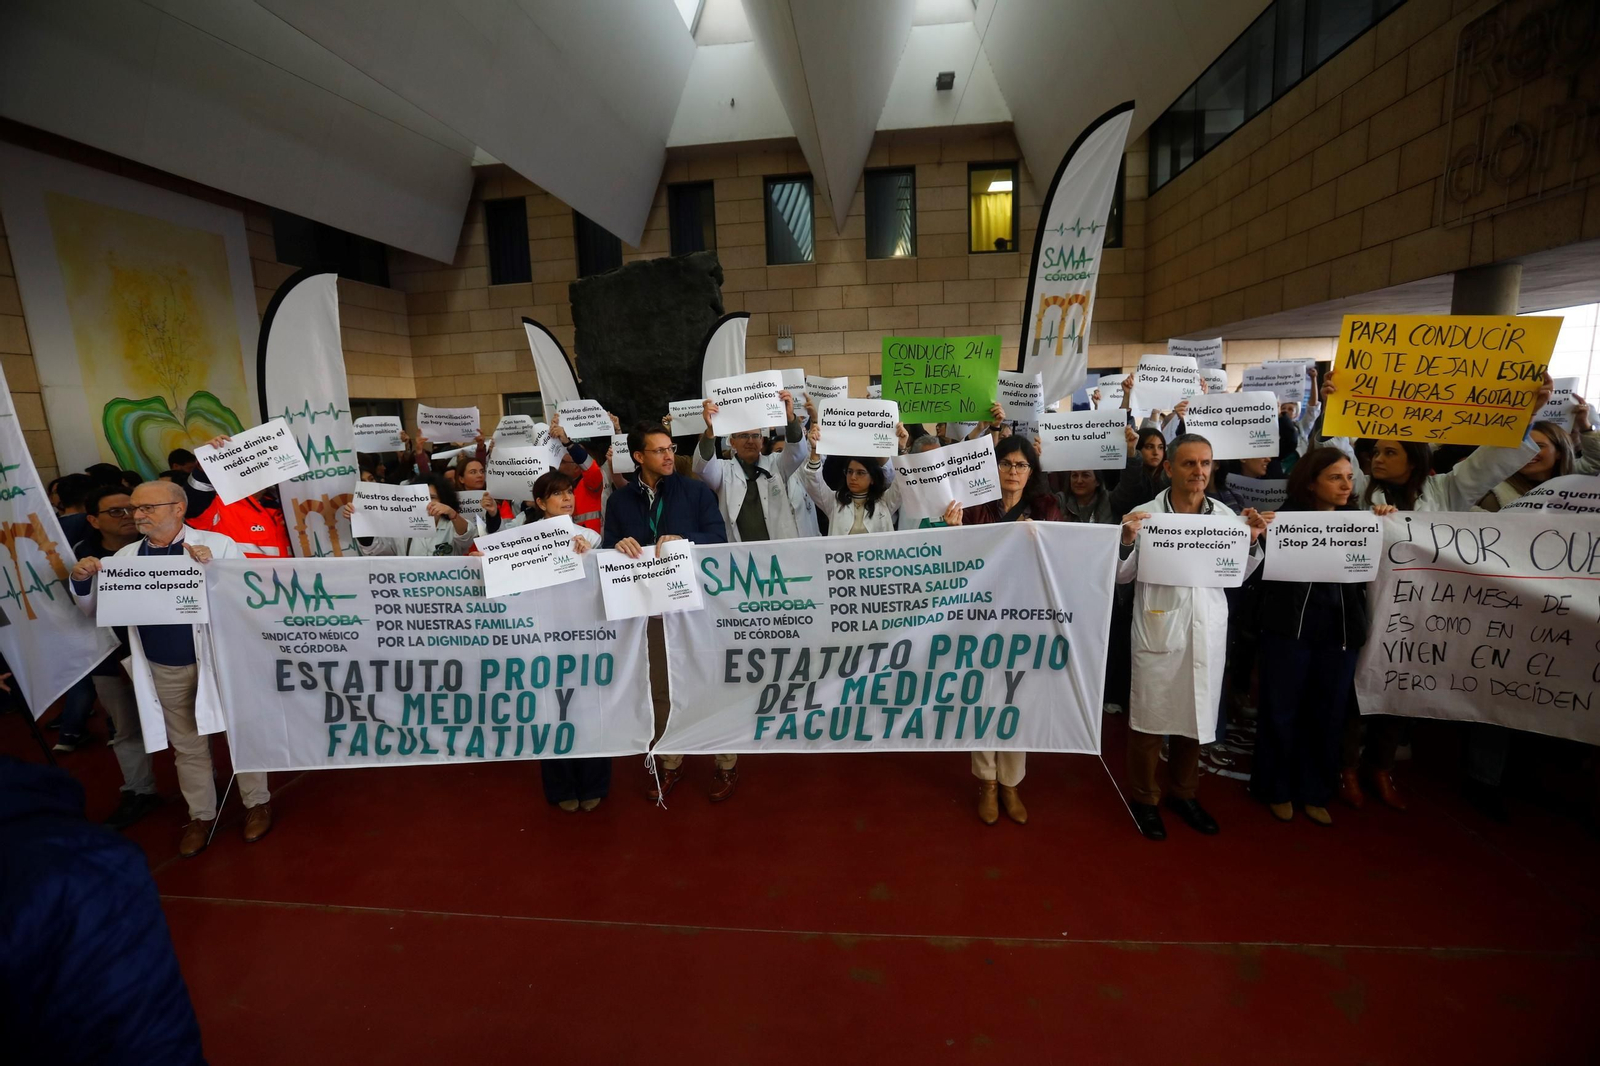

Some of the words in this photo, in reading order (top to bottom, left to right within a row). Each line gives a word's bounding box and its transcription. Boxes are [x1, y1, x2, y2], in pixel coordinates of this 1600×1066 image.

[1043, 245, 1094, 271] SMA
[1349, 320, 1397, 346] PARA
[1409, 322, 1526, 354] CONDUCIR
[888, 343, 955, 360] CONDUCIR
[964, 341, 984, 360] 24
[893, 362, 916, 376] ES
[1136, 364, 1168, 373] ¡Mónica,
[1345, 348, 1372, 370] NO
[1382, 352, 1408, 372] TE
[1414, 355, 1489, 378] DEJAN
[1496, 360, 1548, 382] ESTAR
[1138, 374, 1158, 383] ¡Stop
[1172, 375, 1196, 384] horas!
[713, 387, 742, 396] “Faltan
[894, 380, 962, 396] ATENDER
[1002, 390, 1028, 398] médico
[1350, 373, 1378, 395] 24
[1389, 380, 1457, 400] HORAS
[1464, 386, 1536, 407] AGOTADO
[823, 408, 855, 417] ¡Mónica
[857, 410, 893, 418] petarda,
[1225, 402, 1274, 415] quemado,
[1342, 400, 1394, 420] PERO
[1403, 406, 1443, 422] PARA
[1451, 410, 1518, 430] SALVAR
[858, 421, 894, 429] guardia!
[1040, 422, 1083, 430] “Nuestros
[1085, 420, 1124, 429] derechos
[1186, 419, 1218, 427] sistema
[1221, 414, 1276, 427] colapsado”
[1356, 420, 1413, 436] VIDAS
[276, 428, 285, 437] el
[1083, 431, 1111, 440] salud”
[223, 454, 256, 471] médico
[256, 449, 268, 458] no
[268, 444, 279, 452] te
[495, 457, 541, 466] conciliación,
[894, 461, 945, 476] “Queremos
[947, 448, 992, 466] dignidad,
[492, 469, 505, 477] hay
[506, 467, 543, 476] vocación”
[919, 460, 986, 484] temporalidad”
[1143, 526, 1182, 535] “Menos
[1184, 527, 1248, 538] explotación,
[1275, 524, 1322, 536] ¡Mónica,
[1326, 523, 1379, 533] traidora!
[483, 544, 500, 552] “De
[500, 537, 532, 548] España
[540, 528, 569, 539] Berlín,
[1153, 540, 1175, 548] más
[1177, 541, 1236, 550] protección”
[1279, 538, 1308, 549] ¡Stop
[1312, 538, 1326, 547] 24
[1330, 537, 1367, 547] horas!
[488, 552, 520, 564] porque
[522, 544, 540, 556] aquí
[542, 543, 553, 551] no
[554, 539, 570, 548] hay
[825, 552, 854, 564] POR
[857, 543, 942, 562] FORMACIÓN
[1346, 554, 1371, 562] SMA
[511, 553, 552, 570] porvenir”
[600, 562, 635, 573] “Menos
[636, 553, 688, 569] explotación,
[827, 569, 856, 581] POR
[859, 558, 985, 579] RESPONSABILIDAD
[1216, 558, 1239, 566] SMA
[101, 568, 146, 578] “Médico
[149, 567, 202, 578] quemado,
[369, 573, 396, 584] POR
[399, 566, 481, 583] FORMACIÓN
[612, 574, 631, 584] más
[633, 564, 680, 583] protección”
[701, 551, 813, 599] SMA
[99, 583, 141, 591] sistema
[144, 580, 203, 591] colapsado”
[244, 568, 357, 614] SMA
[371, 588, 401, 598] POR
[828, 586, 857, 598] POR
[860, 582, 922, 597] NUESTRA
[925, 577, 968, 593] SALUD
[176, 596, 198, 604] SMA
[830, 603, 859, 616] POR
[862, 598, 929, 614] NUESTRAS
[932, 591, 993, 608] FAMILIAS
[1393, 579, 1424, 604] EN
[1431, 582, 1456, 603] LA
[1463, 584, 1523, 609] MESA
[1541, 594, 1572, 615] DE
[375, 604, 402, 614] POR
[405, 603, 464, 614] NUESTRA
[466, 602, 507, 614] SALUD
[376, 620, 404, 631] POR
[407, 620, 472, 631] NUESTRAS
[474, 617, 534, 630] FAMILIAS
[716, 618, 771, 628] SINDICATO
[774, 614, 813, 626] MÉDICO
[831, 620, 858, 633] POR
[862, 620, 879, 632] LA
[881, 612, 944, 630] DIGNIDAD
[947, 609, 964, 621] DE
[967, 609, 998, 621] UNA
[1001, 608, 1073, 624] PROFESIÓN
[262, 632, 317, 642] SINDICATO
[319, 630, 359, 641] MÉDICO
[378, 636, 405, 648] POR
[408, 636, 425, 647] LA
[428, 635, 489, 647] DIGNIDAD
[492, 635, 508, 646] DE
[512, 633, 541, 645] UNA
[544, 627, 616, 642] PROFESIÓN
[734, 631, 747, 640] DE
[749, 628, 800, 640] CÓRDOBA
[1386, 613, 1414, 632] ES
[1426, 614, 1471, 635] COMO
[1486, 620, 1514, 639] EN
[1530, 625, 1573, 646] UNA
[280, 644, 292, 654] DE
[294, 642, 348, 654] CÓRDOBA
[724, 639, 913, 683] ESTATUTO
[928, 633, 1070, 671] PROPIO
[1471, 645, 1510, 669] EN
[1526, 652, 1561, 678] EL
[276, 659, 463, 694] ESTATUTO
[480, 653, 614, 692] PROPIO
[755, 681, 823, 714] DEL
[840, 664, 985, 706] MÉDICO
[1004, 670, 1026, 704] Y
[1384, 670, 1437, 691] PERO
[1450, 673, 1478, 692] LO
[1490, 678, 1592, 712] DECIDEN
[324, 691, 386, 723] DEL
[401, 685, 536, 726] MÉDICO
[555, 688, 574, 721] Y
[754, 705, 1020, 741] FACULTATIVO
[327, 722, 576, 758] FACULTATIVO
